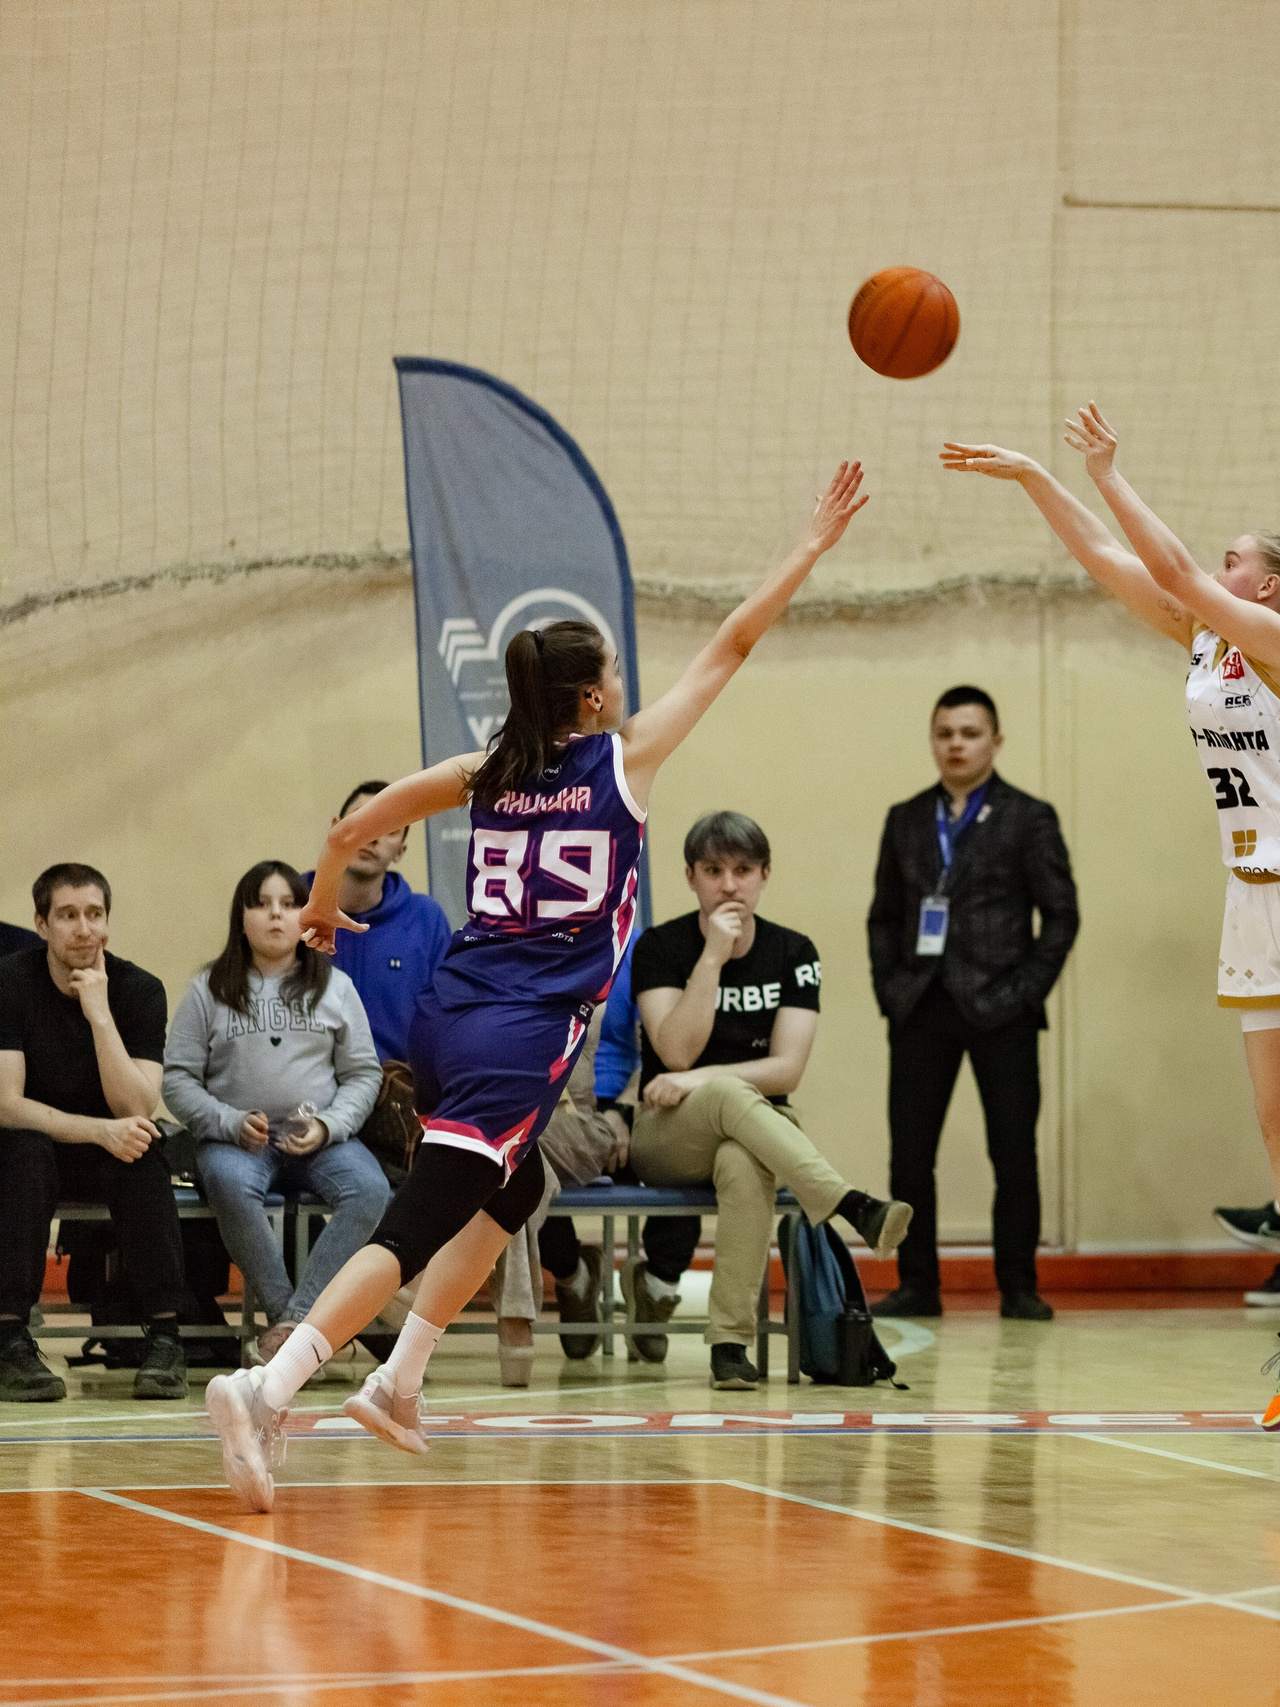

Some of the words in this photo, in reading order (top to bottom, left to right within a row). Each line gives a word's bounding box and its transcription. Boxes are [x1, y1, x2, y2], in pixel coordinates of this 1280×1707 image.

[1207, 767, 1260, 809] 32
[472, 828, 611, 918] 89
[227, 997, 326, 1041] ANGEL
